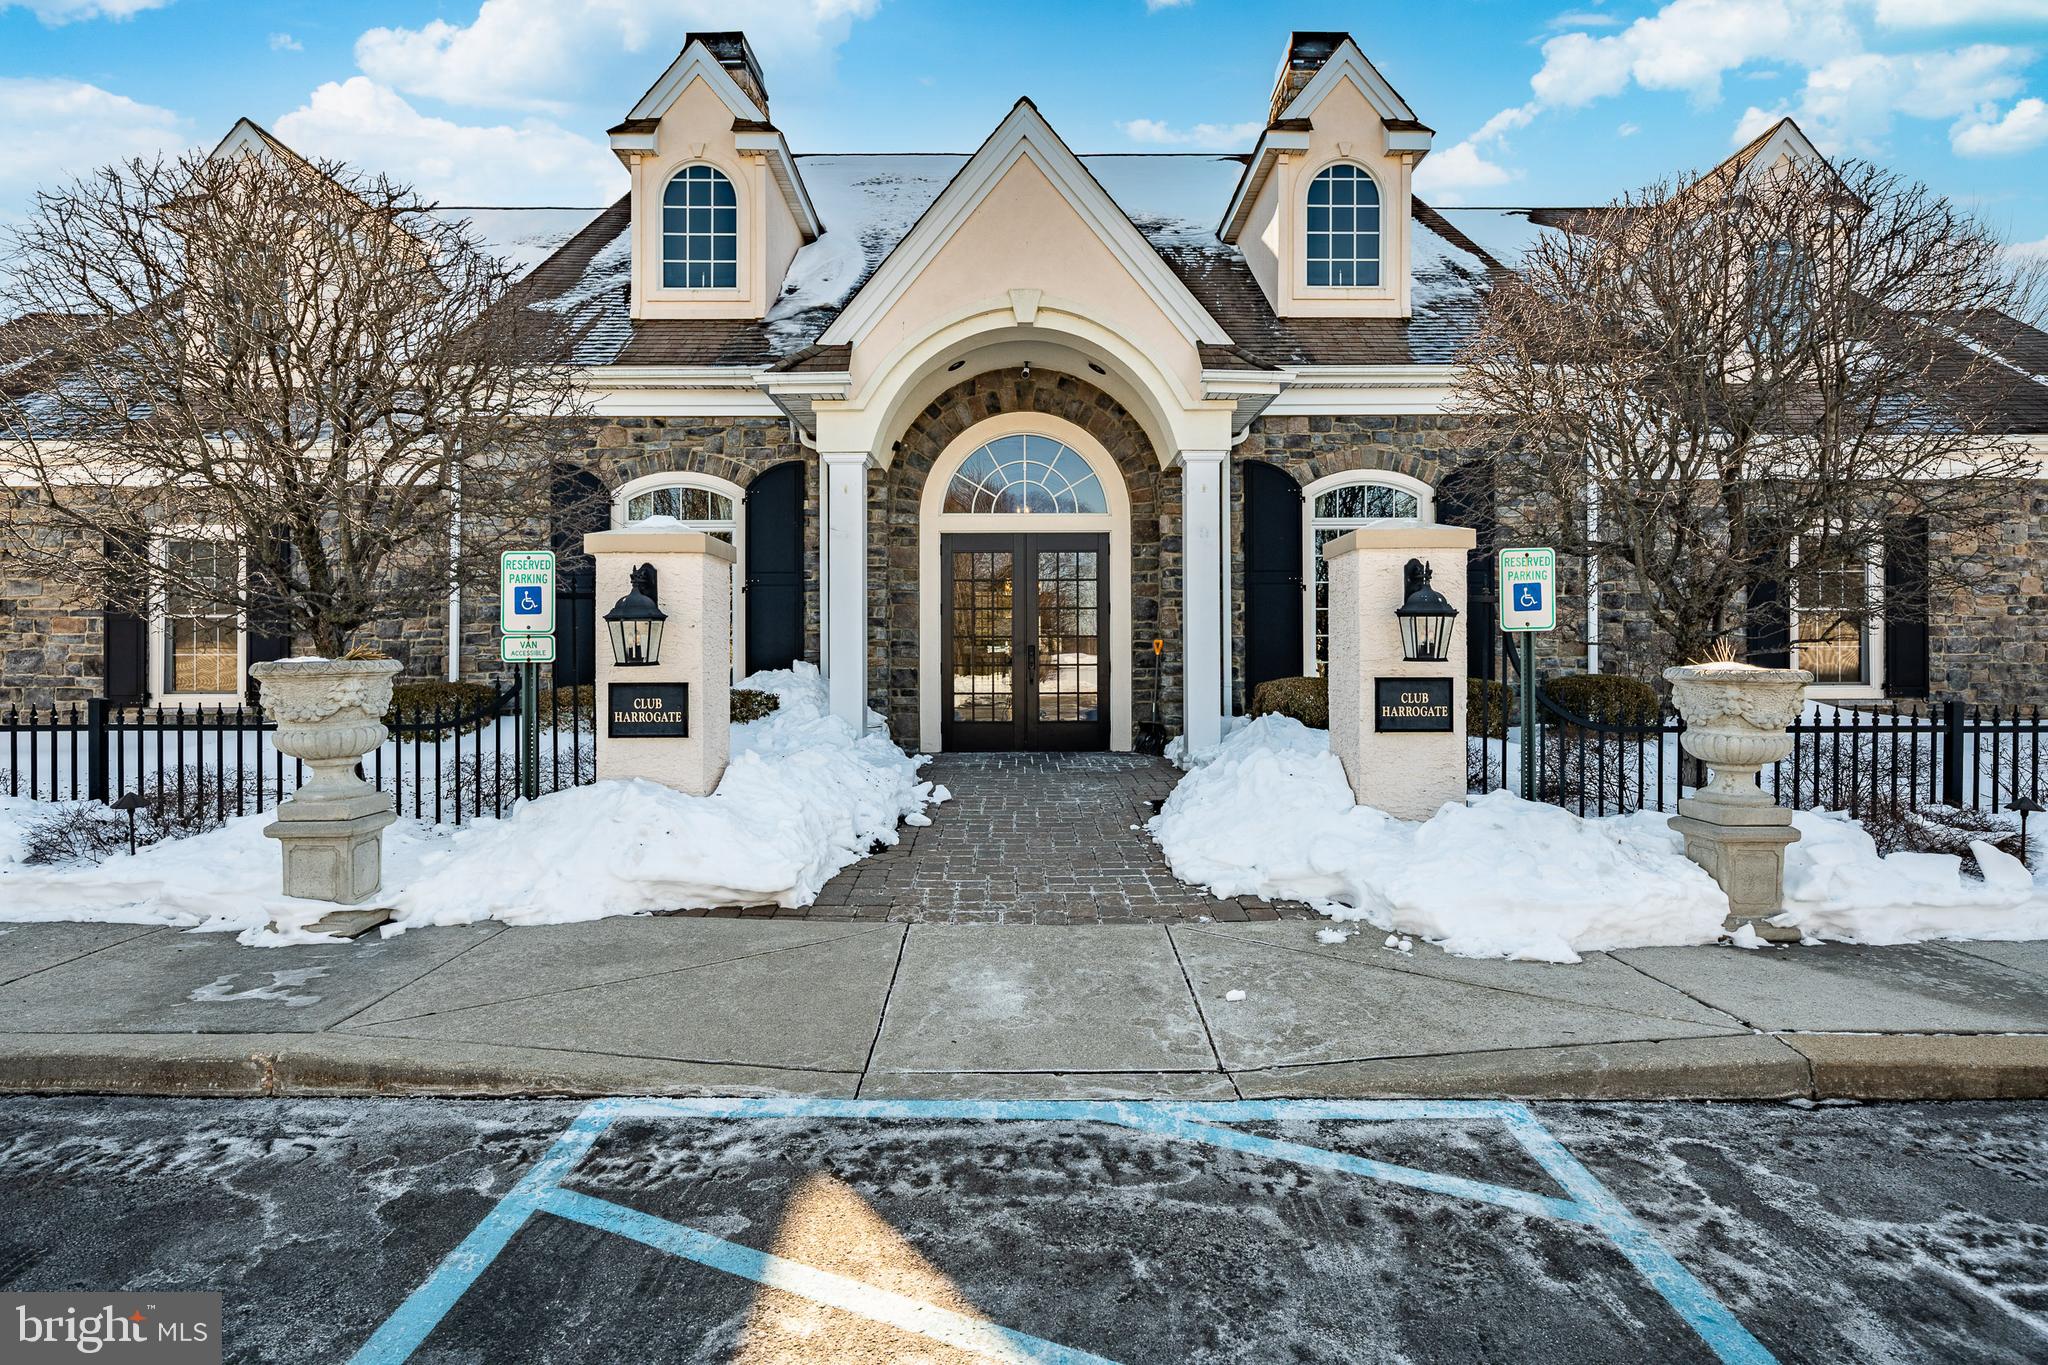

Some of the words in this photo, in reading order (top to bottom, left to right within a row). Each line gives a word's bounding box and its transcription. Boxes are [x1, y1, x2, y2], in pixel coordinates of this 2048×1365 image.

[505, 559, 551, 570] RESERVED
[1504, 556, 1551, 568] RESERVED
[508, 573, 548, 584] PARKING
[1507, 570, 1548, 581] PARKING
[520, 641, 538, 649] VAN
[511, 649, 546, 657] ACCESSIBLE
[1400, 692, 1429, 704] CLUB
[633, 698, 663, 710] CLUB
[614, 711, 682, 723] HARROGATE
[1382, 706, 1449, 717] HARROGATE
